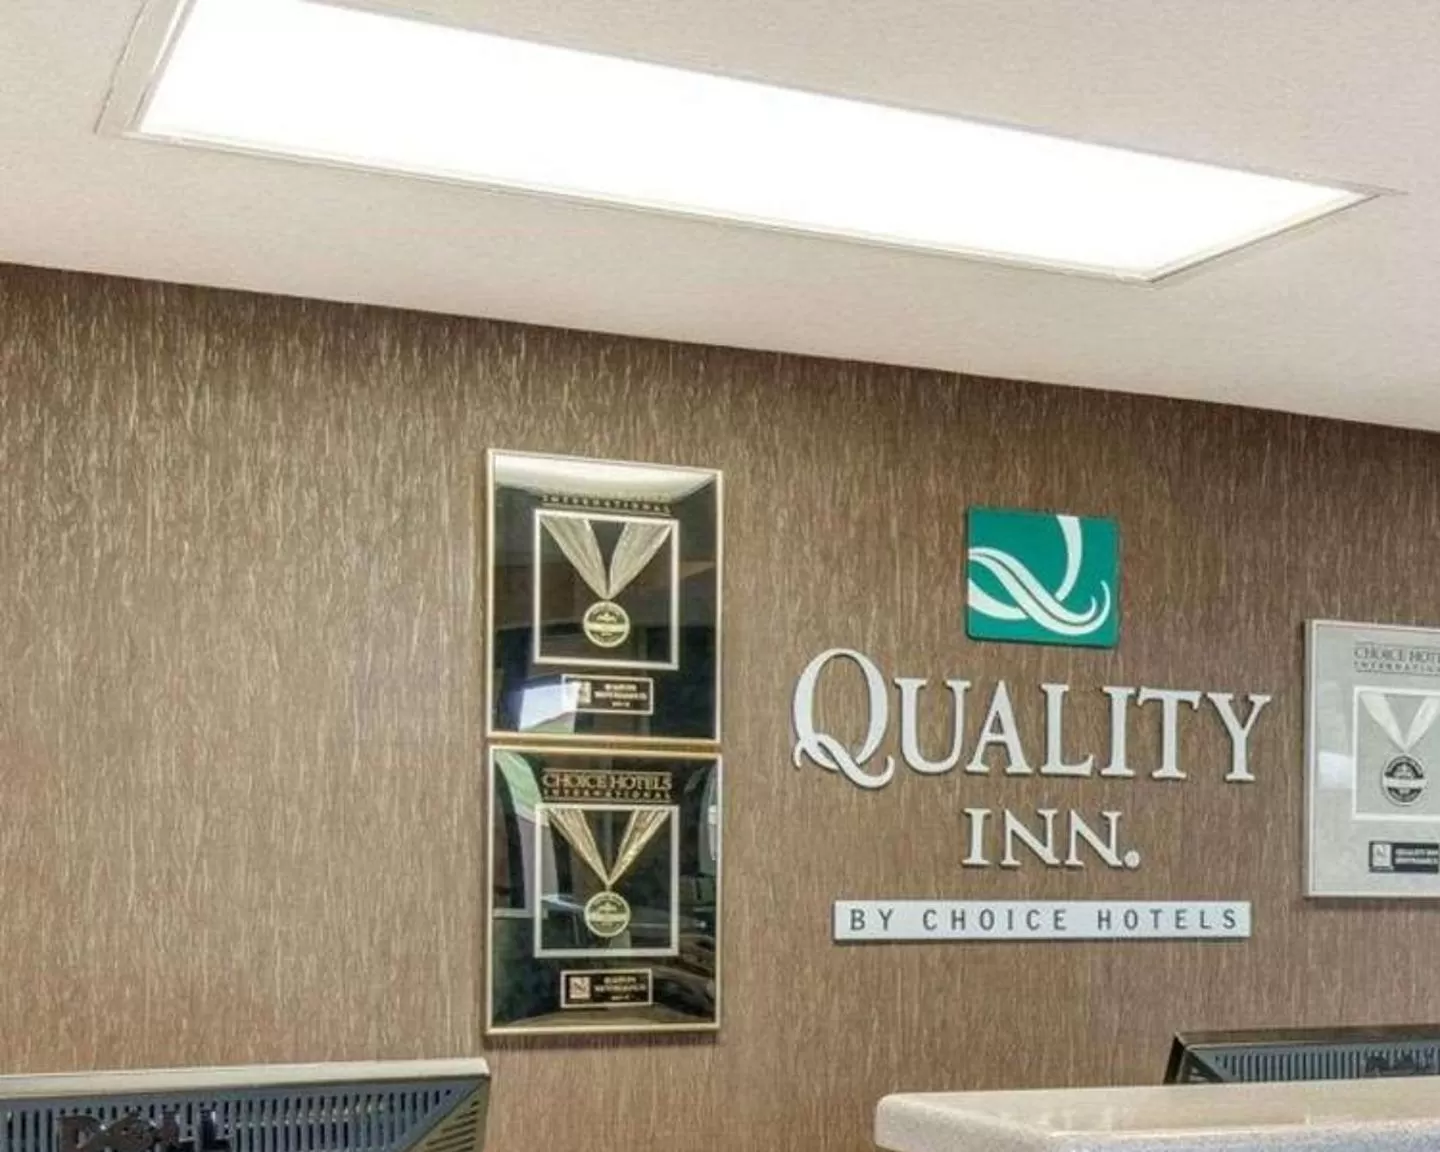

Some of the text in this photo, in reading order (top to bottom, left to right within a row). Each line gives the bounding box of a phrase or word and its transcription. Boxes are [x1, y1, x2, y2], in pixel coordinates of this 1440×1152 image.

[793, 647, 1273, 788] QUALITY
[541, 771, 673, 790] CHOICE HOTELS
[962, 808, 1141, 869] INN.
[849, 907, 1238, 932] BY CHOICE HOTELS
